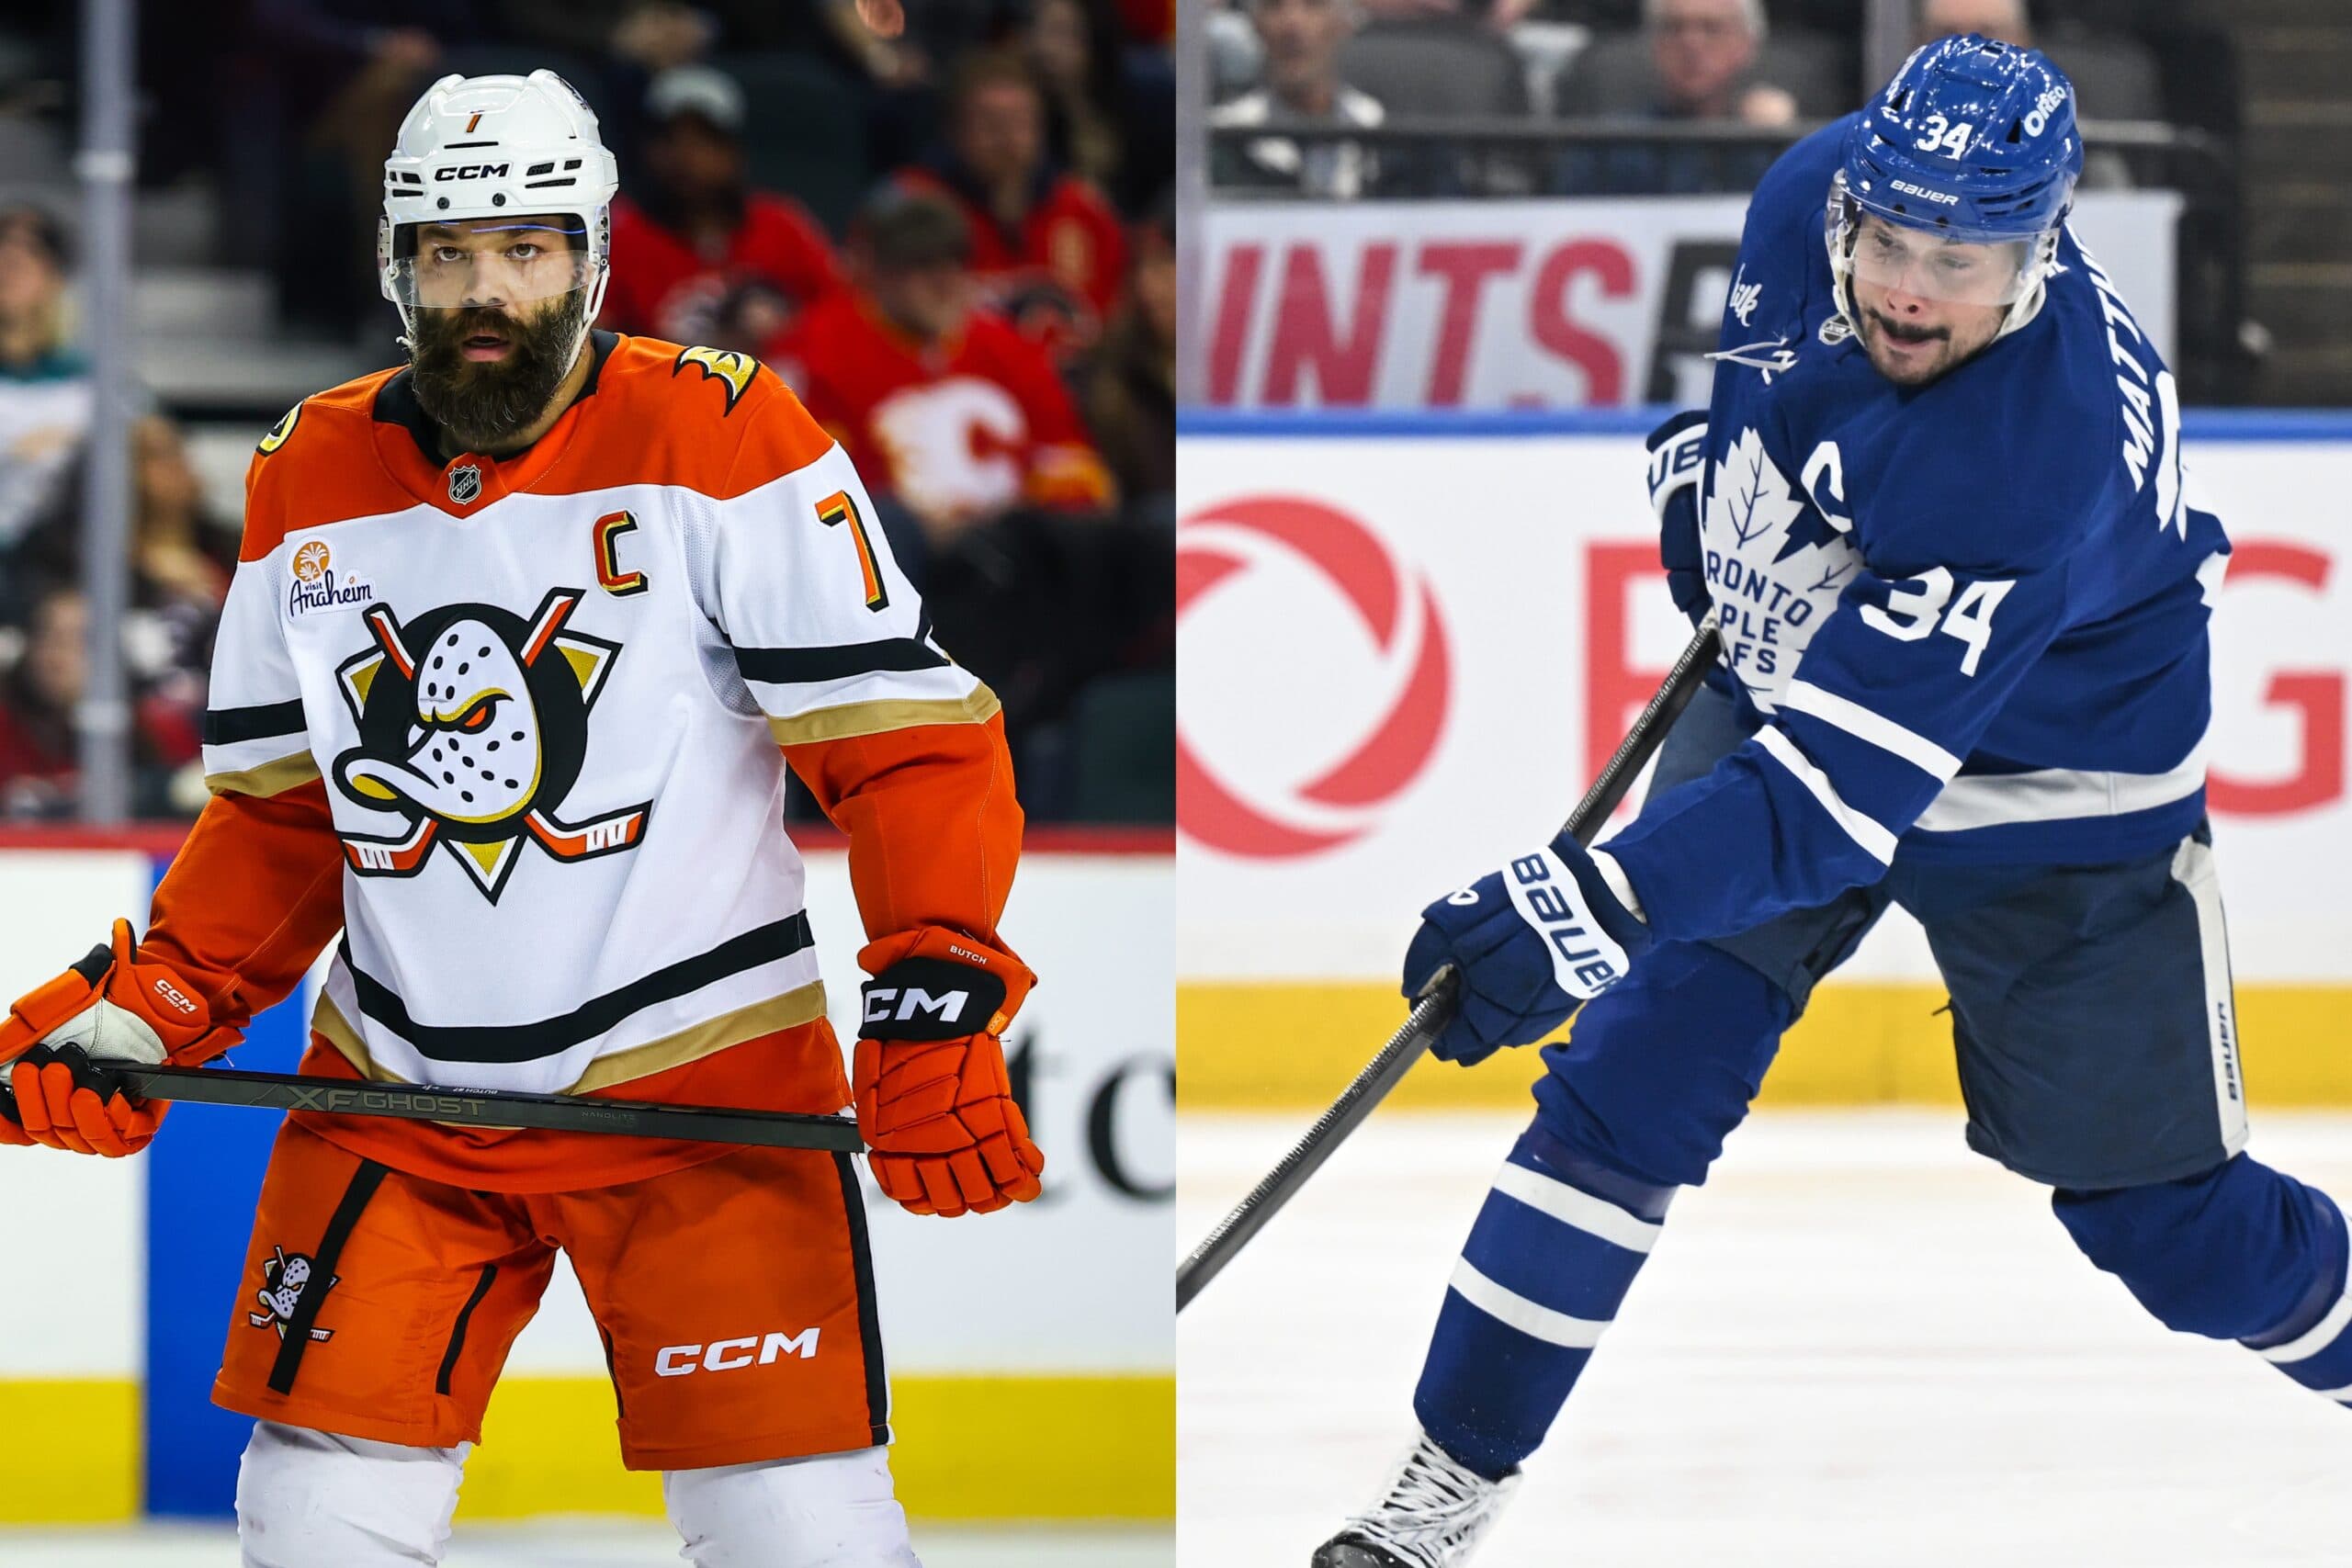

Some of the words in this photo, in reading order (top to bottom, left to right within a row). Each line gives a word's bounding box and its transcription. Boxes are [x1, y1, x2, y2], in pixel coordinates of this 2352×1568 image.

[2024, 85, 2067, 138] OREO
[1916, 115, 1973, 161] 34
[435, 163, 510, 182] CCM
[456, 475, 475, 497] NHL
[1800, 441, 1853, 533] C
[592, 510, 649, 597] C
[814, 490, 889, 613] 7
[289, 569, 373, 617] Anaheim
[304, 581, 323, 592] visit
[1859, 565, 2017, 678] 34
[949, 944, 988, 965] BUTCH
[155, 978, 198, 1012] CCM
[362, 1091, 487, 1117] GHOST
[654, 1327, 821, 1377] CCM
